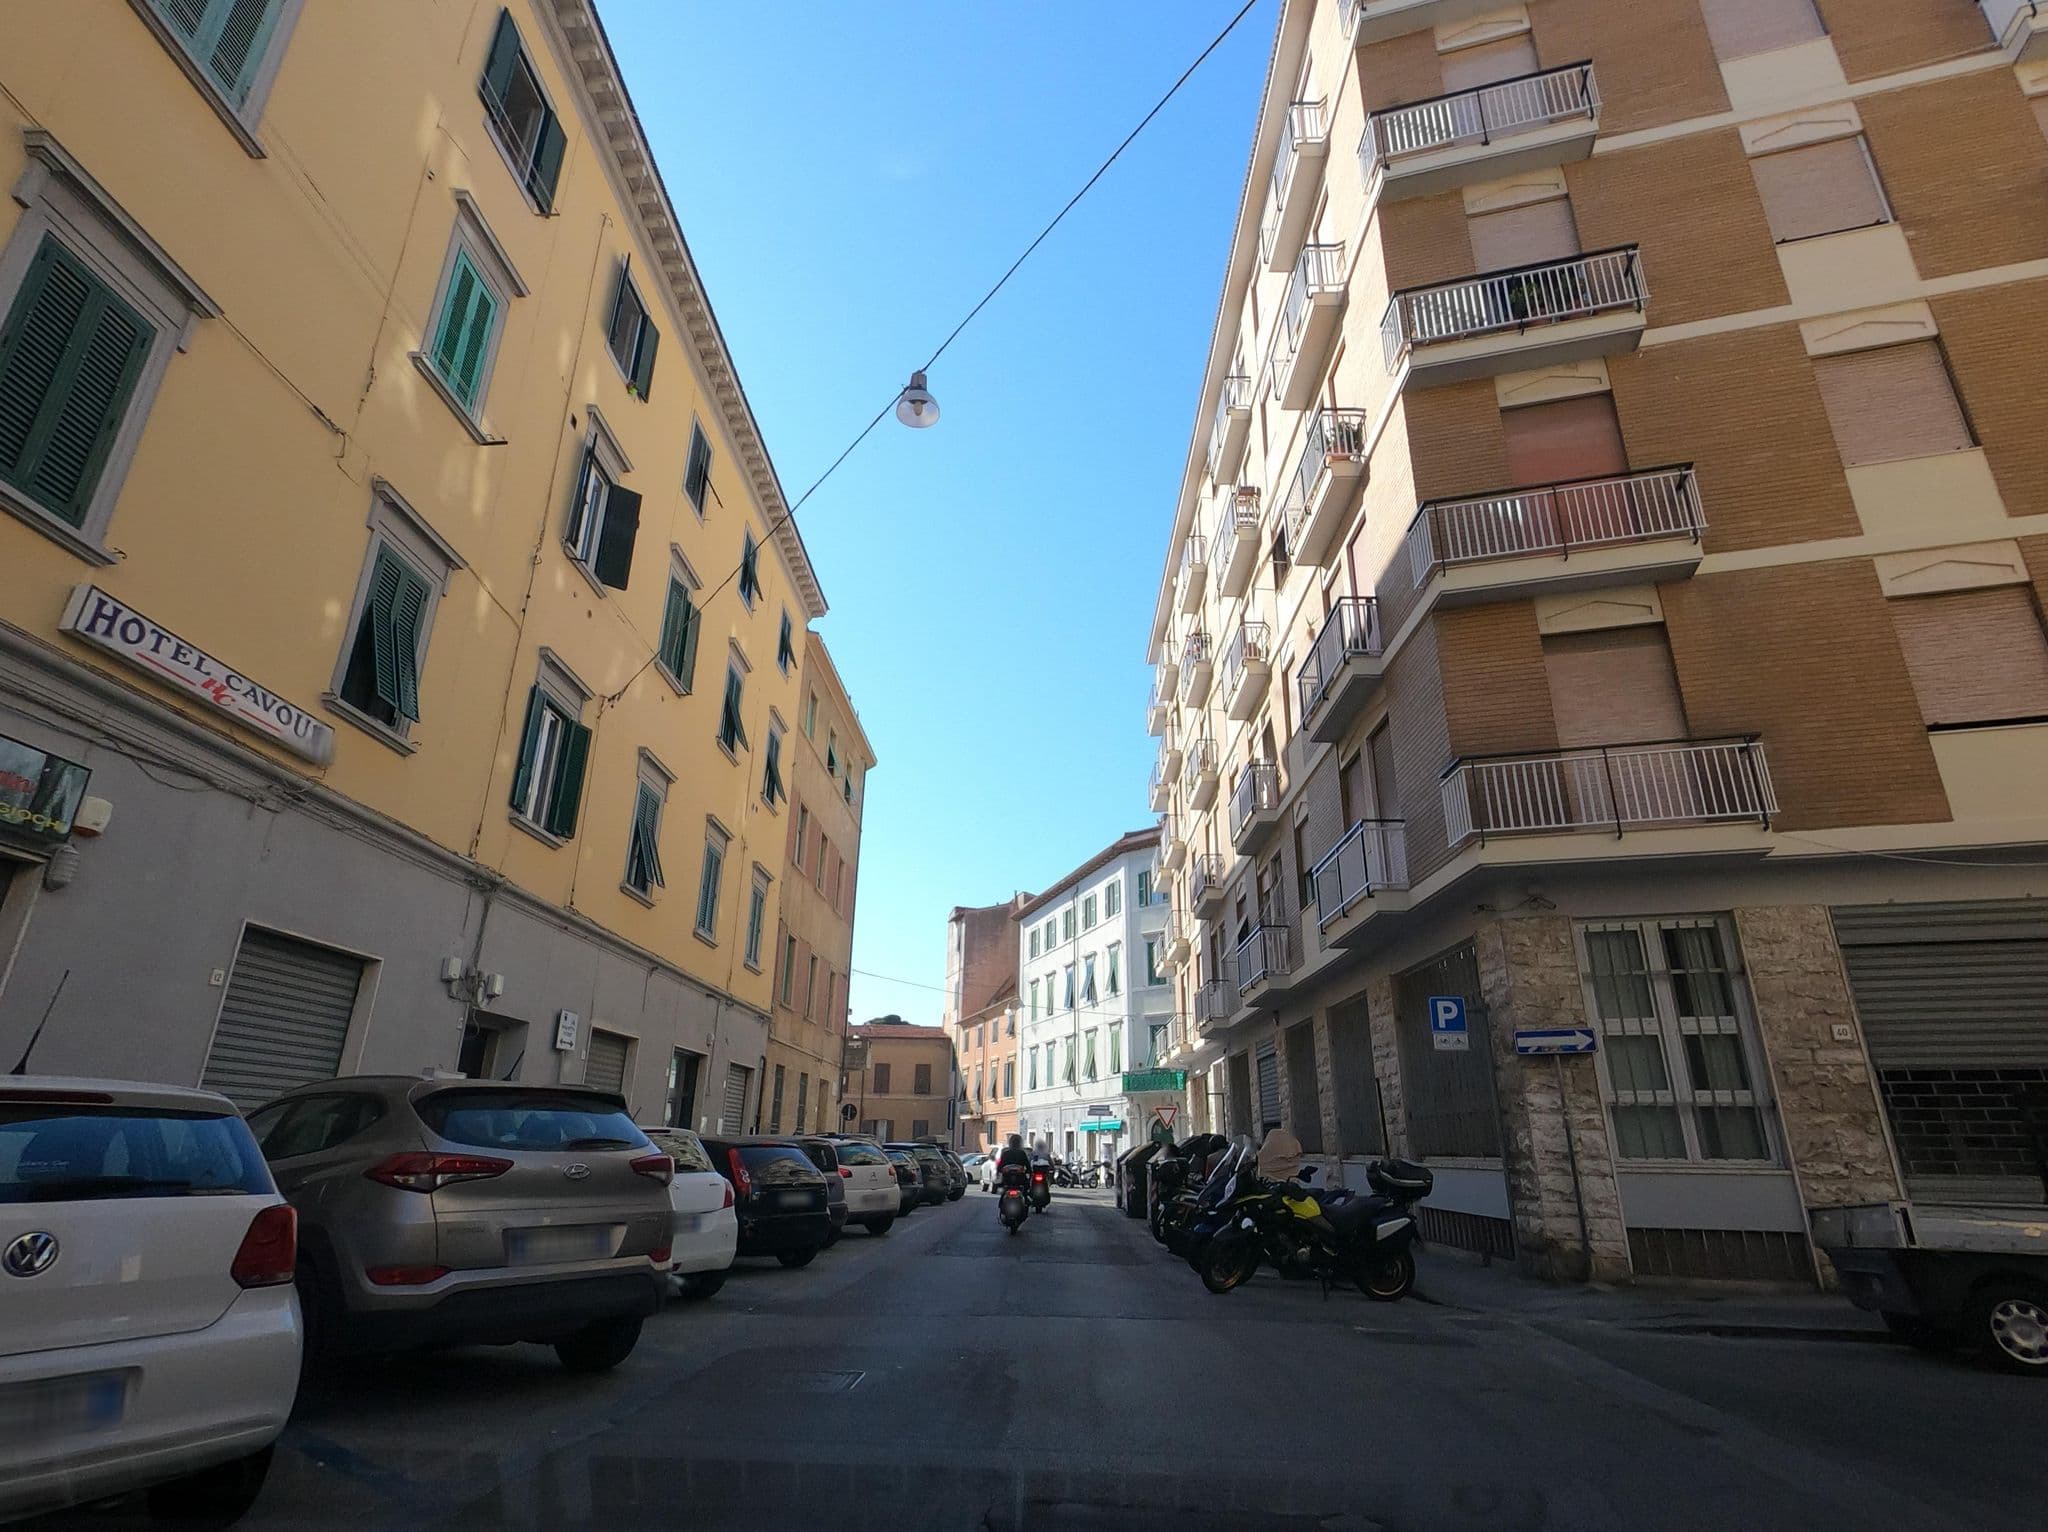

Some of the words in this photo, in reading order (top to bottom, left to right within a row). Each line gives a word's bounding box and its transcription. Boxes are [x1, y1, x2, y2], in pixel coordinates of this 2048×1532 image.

[84, 597, 211, 676] HOTEL
[225, 674, 325, 746] CAVOU
[1437, 1001, 1458, 1028] P
